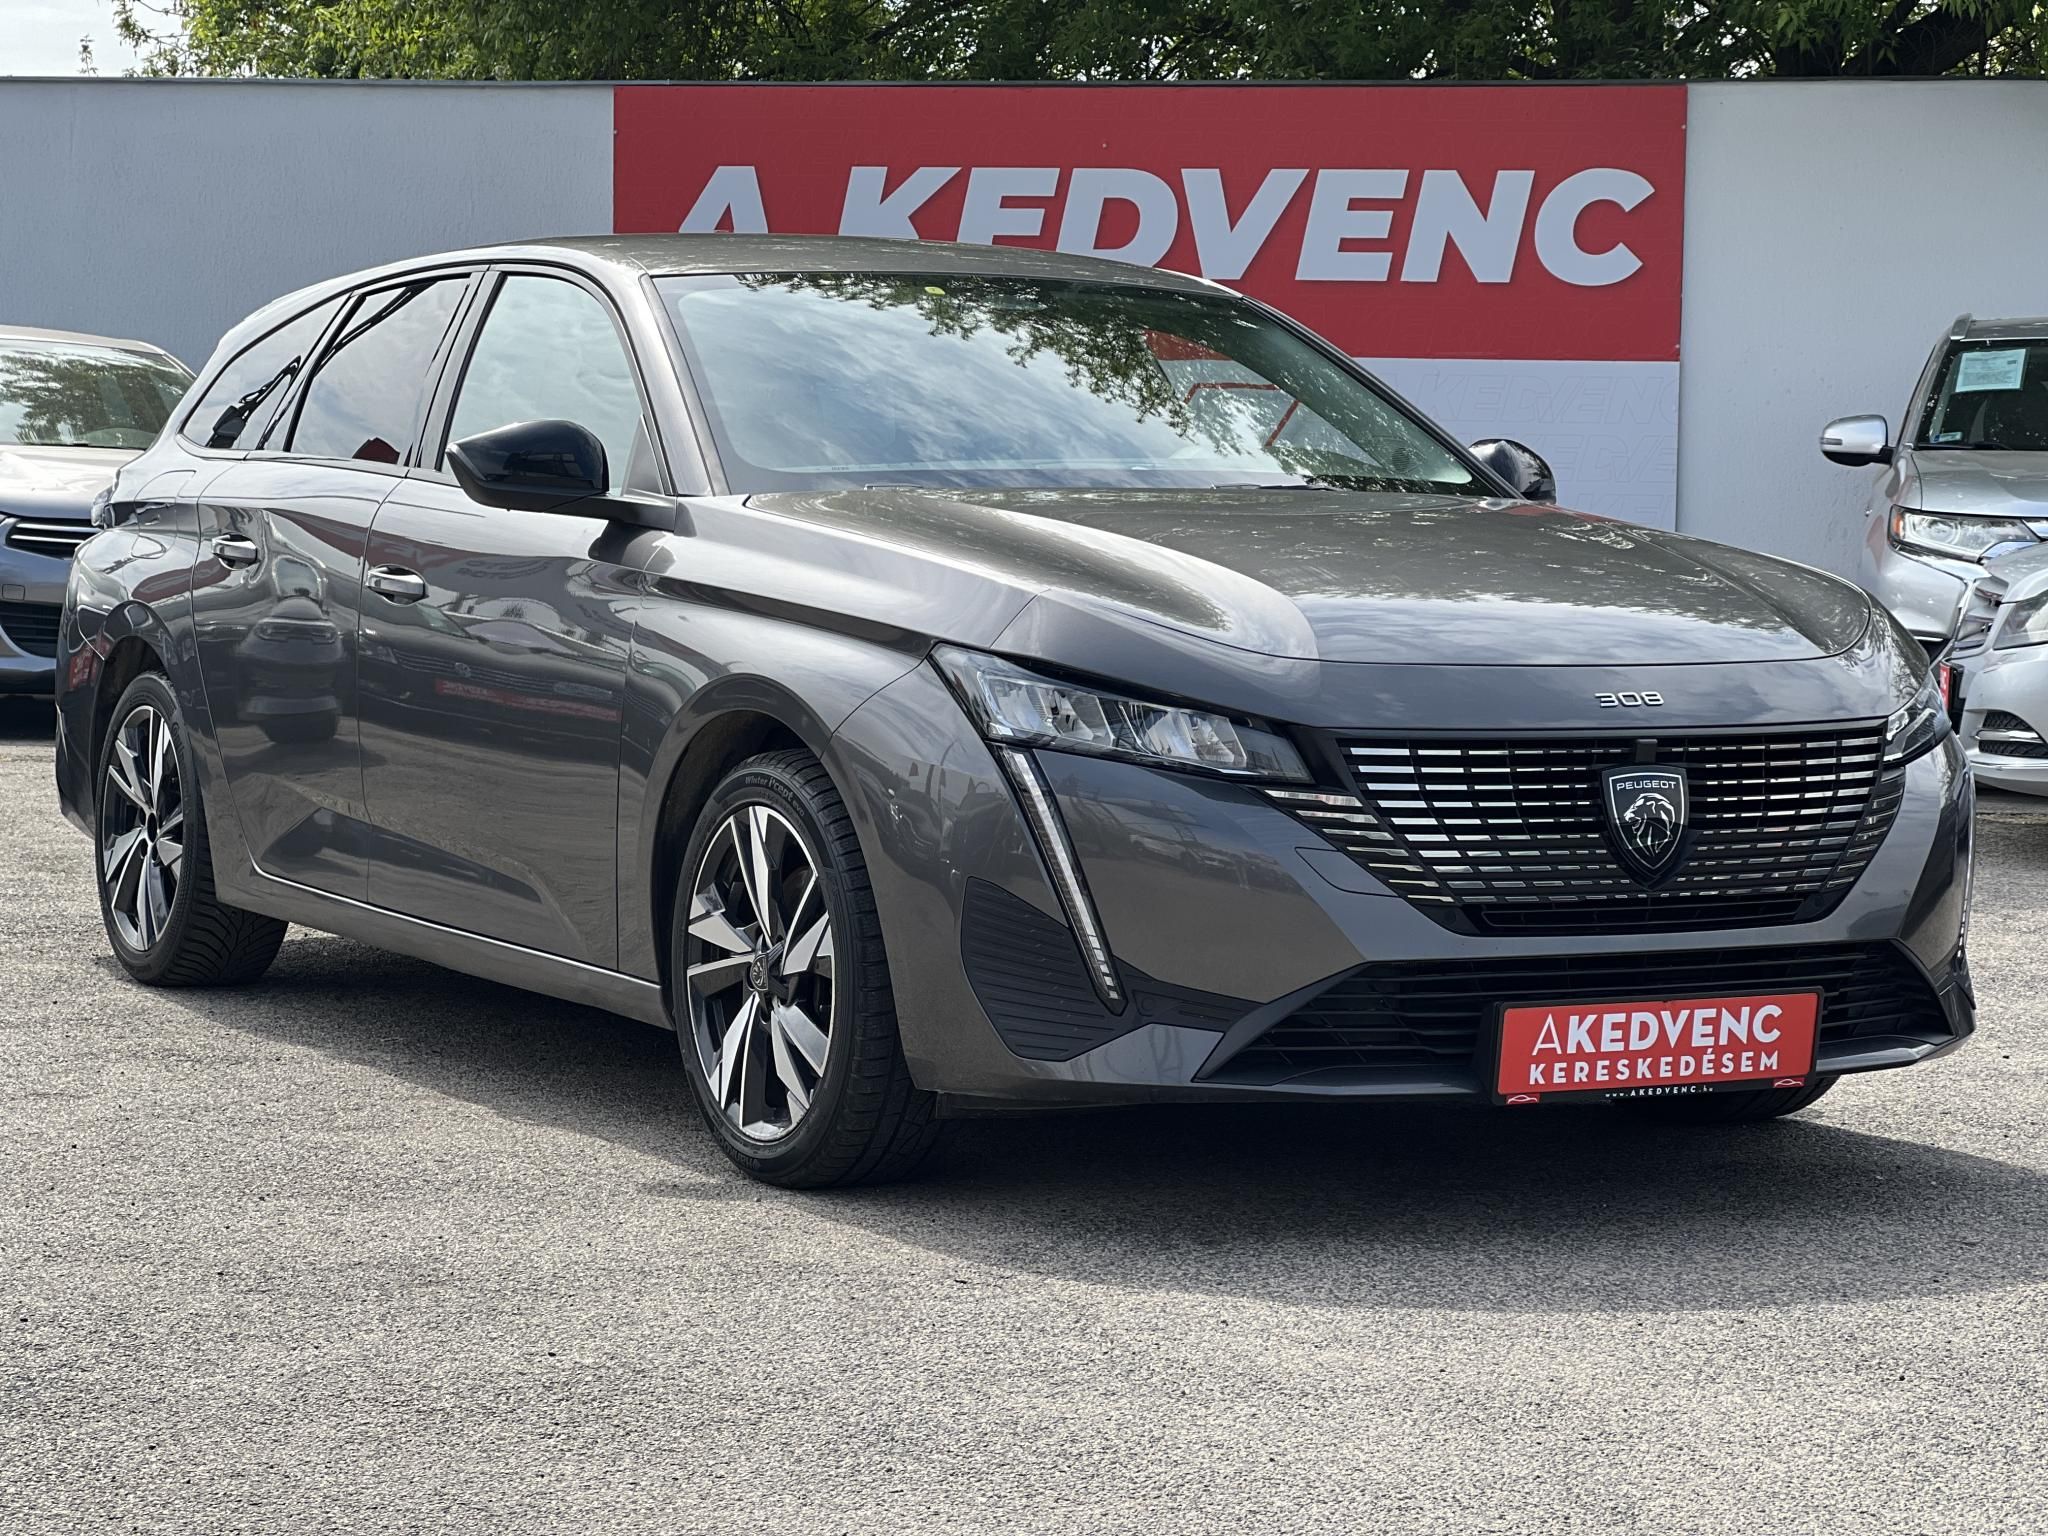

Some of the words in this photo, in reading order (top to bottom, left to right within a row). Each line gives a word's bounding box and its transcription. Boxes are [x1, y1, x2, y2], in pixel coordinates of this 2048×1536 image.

[678, 165, 768, 233] A
[838, 165, 1656, 286] KEDVENC
[1594, 691, 1665, 707] 308
[1616, 780, 1677, 791] PEUGEOT
[1528, 1048, 1779, 1085] KERESKEDÉSEM
